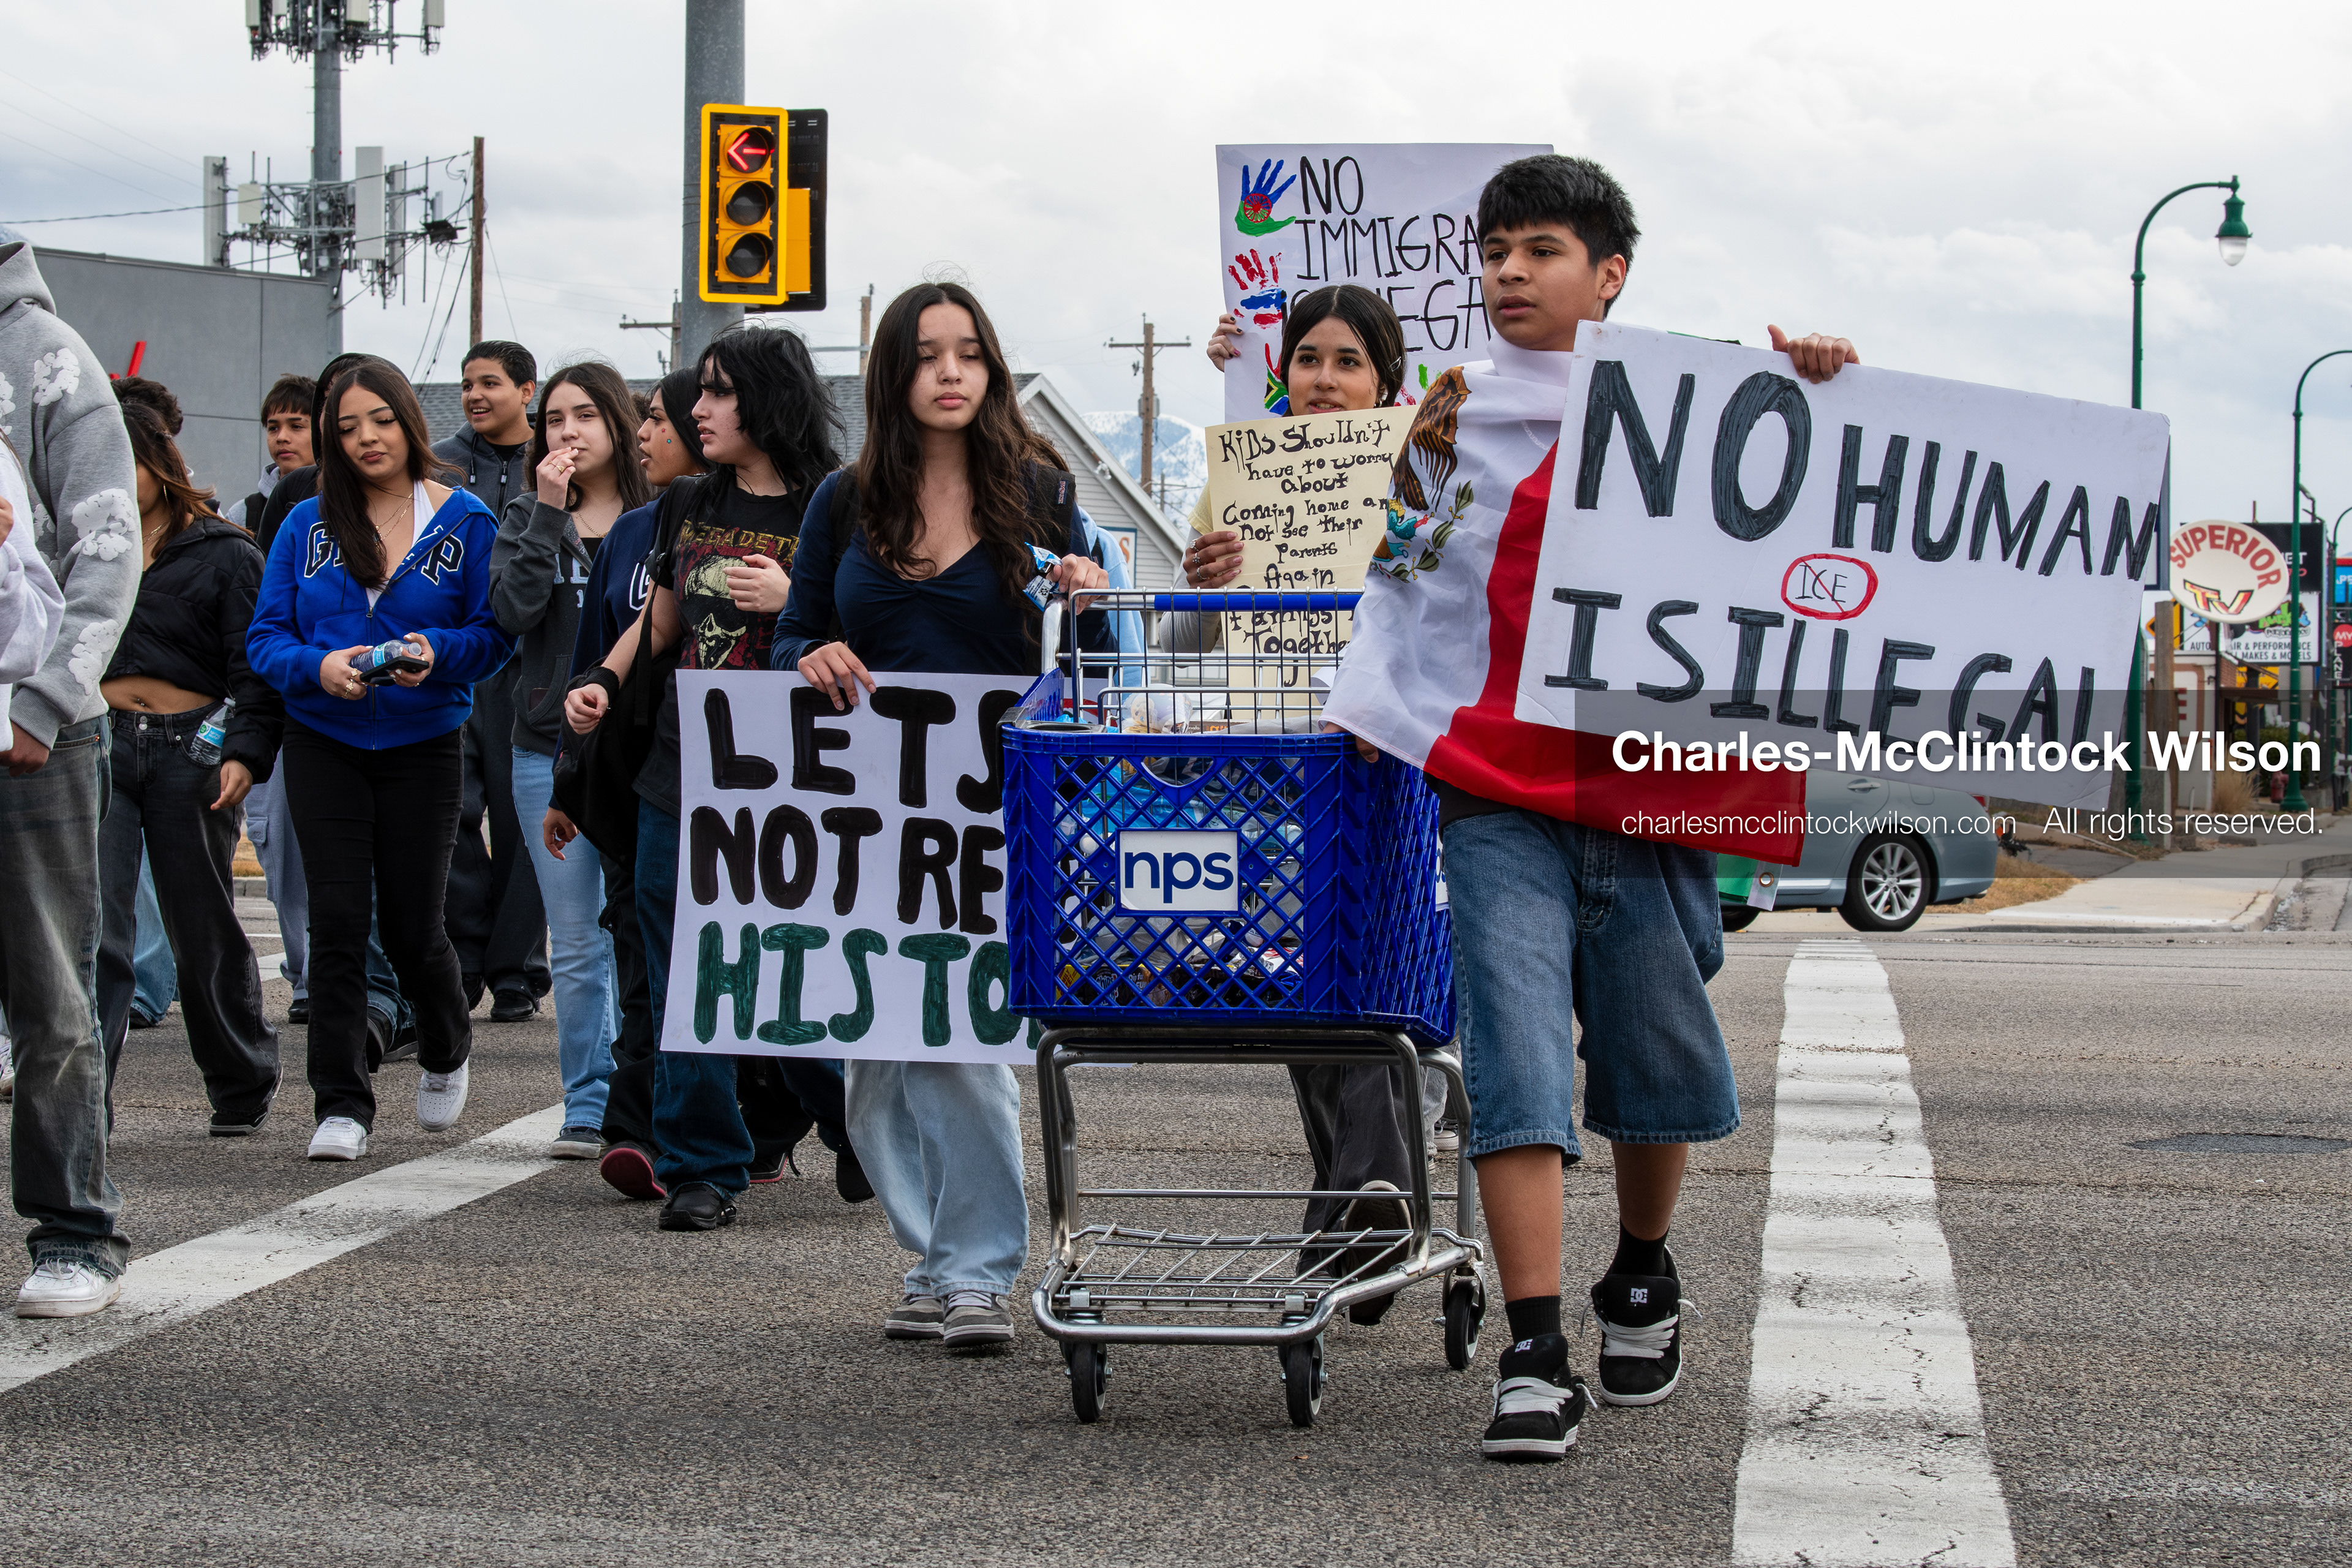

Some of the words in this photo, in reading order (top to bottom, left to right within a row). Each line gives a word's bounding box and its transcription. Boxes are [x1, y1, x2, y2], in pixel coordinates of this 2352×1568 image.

[1300, 156, 1363, 216] NO
[1245, 462, 1293, 480] have
[1302, 459, 1325, 474] to
[1330, 453, 1393, 472] worry
[1575, 360, 1812, 541] NO
[1832, 424, 2158, 581] HUMAN
[1223, 500, 1294, 533] Coming
[1304, 499, 1349, 516] home
[1264, 563, 1335, 589] Again
[1795, 565, 1847, 603] ICE
[2170, 525, 2282, 589] SUPERIOR
[690, 804, 883, 916] NOT
[1125, 852, 1234, 903] nps
[693, 921, 1039, 1050] HISTO
